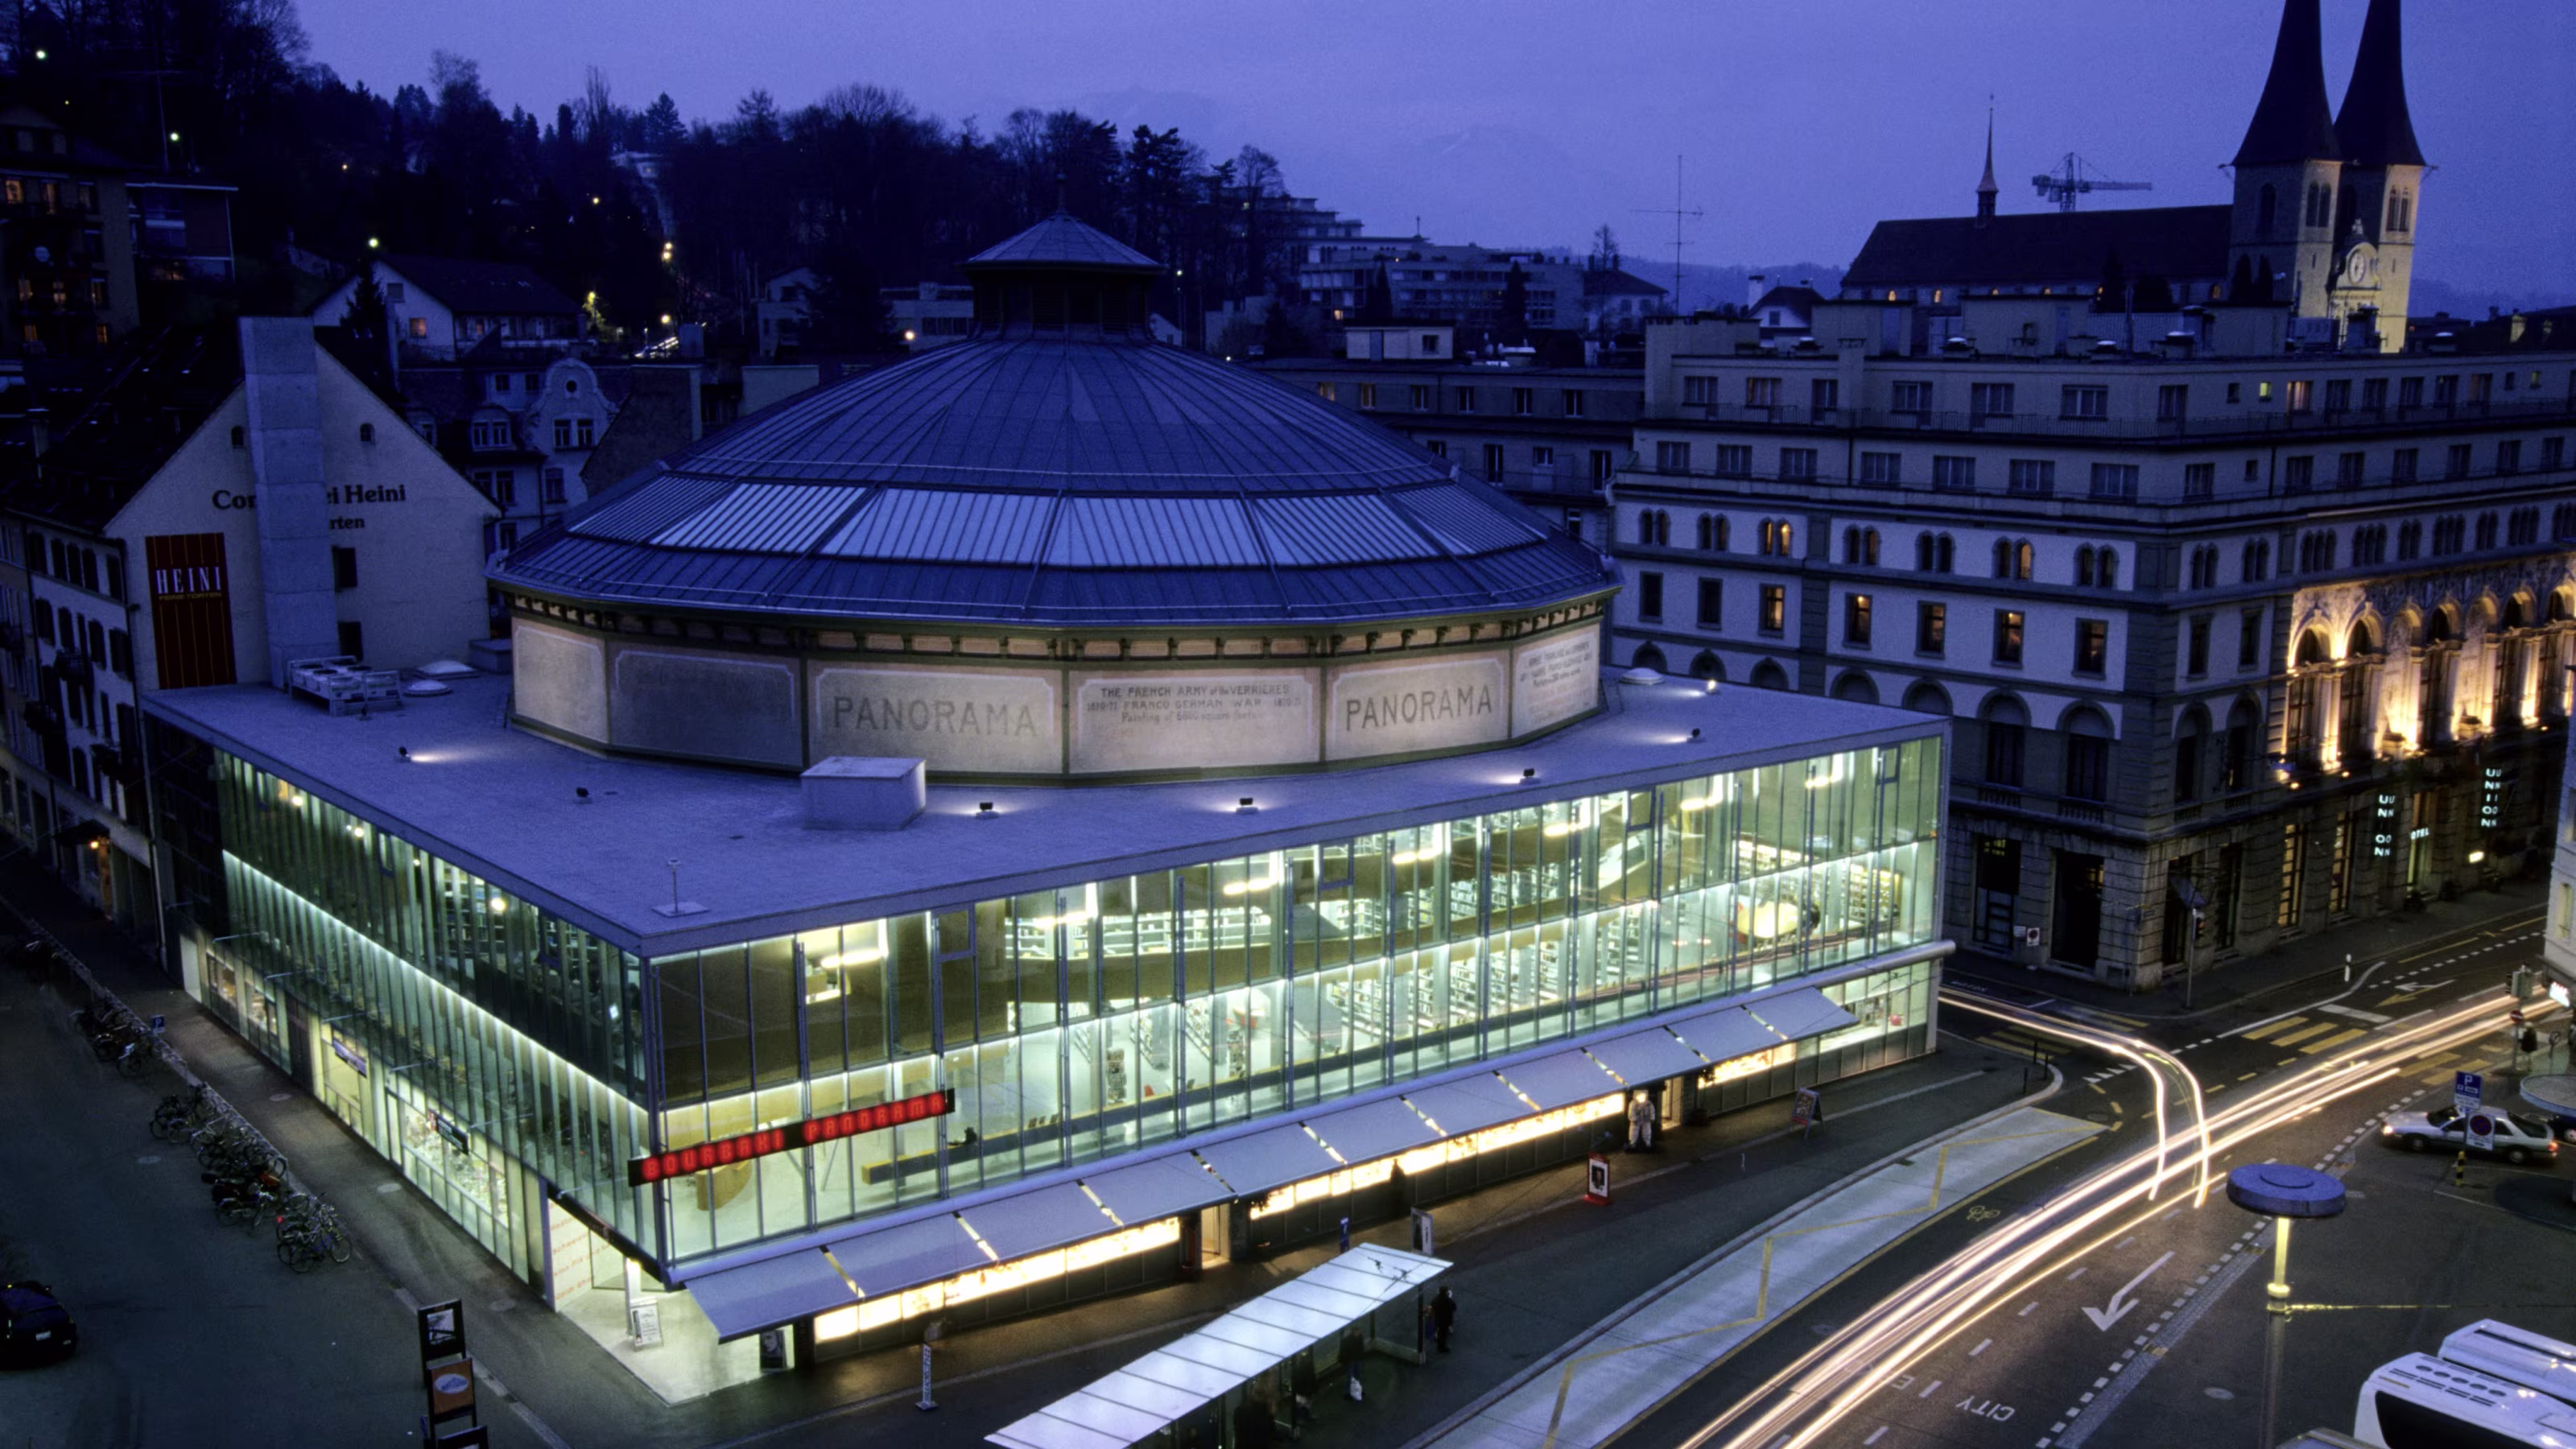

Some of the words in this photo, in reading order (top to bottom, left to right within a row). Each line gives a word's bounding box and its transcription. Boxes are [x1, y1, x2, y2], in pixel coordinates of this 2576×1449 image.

[345, 484, 407, 503] Heini
[155, 566, 221, 594] HEINI
[1101, 687, 1121, 698] THE
[1128, 687, 1171, 698] FRENCH
[1178, 685, 1208, 696] ARMY
[1124, 700, 1170, 710] FRANCO
[1233, 698, 1261, 708] WAR
[832, 695, 1038, 737] PANORAMA
[1346, 684, 1492, 732] PANORAMA
[2481, 768, 2496, 827] UNION
[2410, 827, 2429, 840] OTEL
[2464, 1075, 2473, 1085] P
[643, 1129, 785, 1179] BOURBAKI
[804, 1092, 945, 1143] PANORAMA
[1955, 1395, 2016, 1422] CITY
